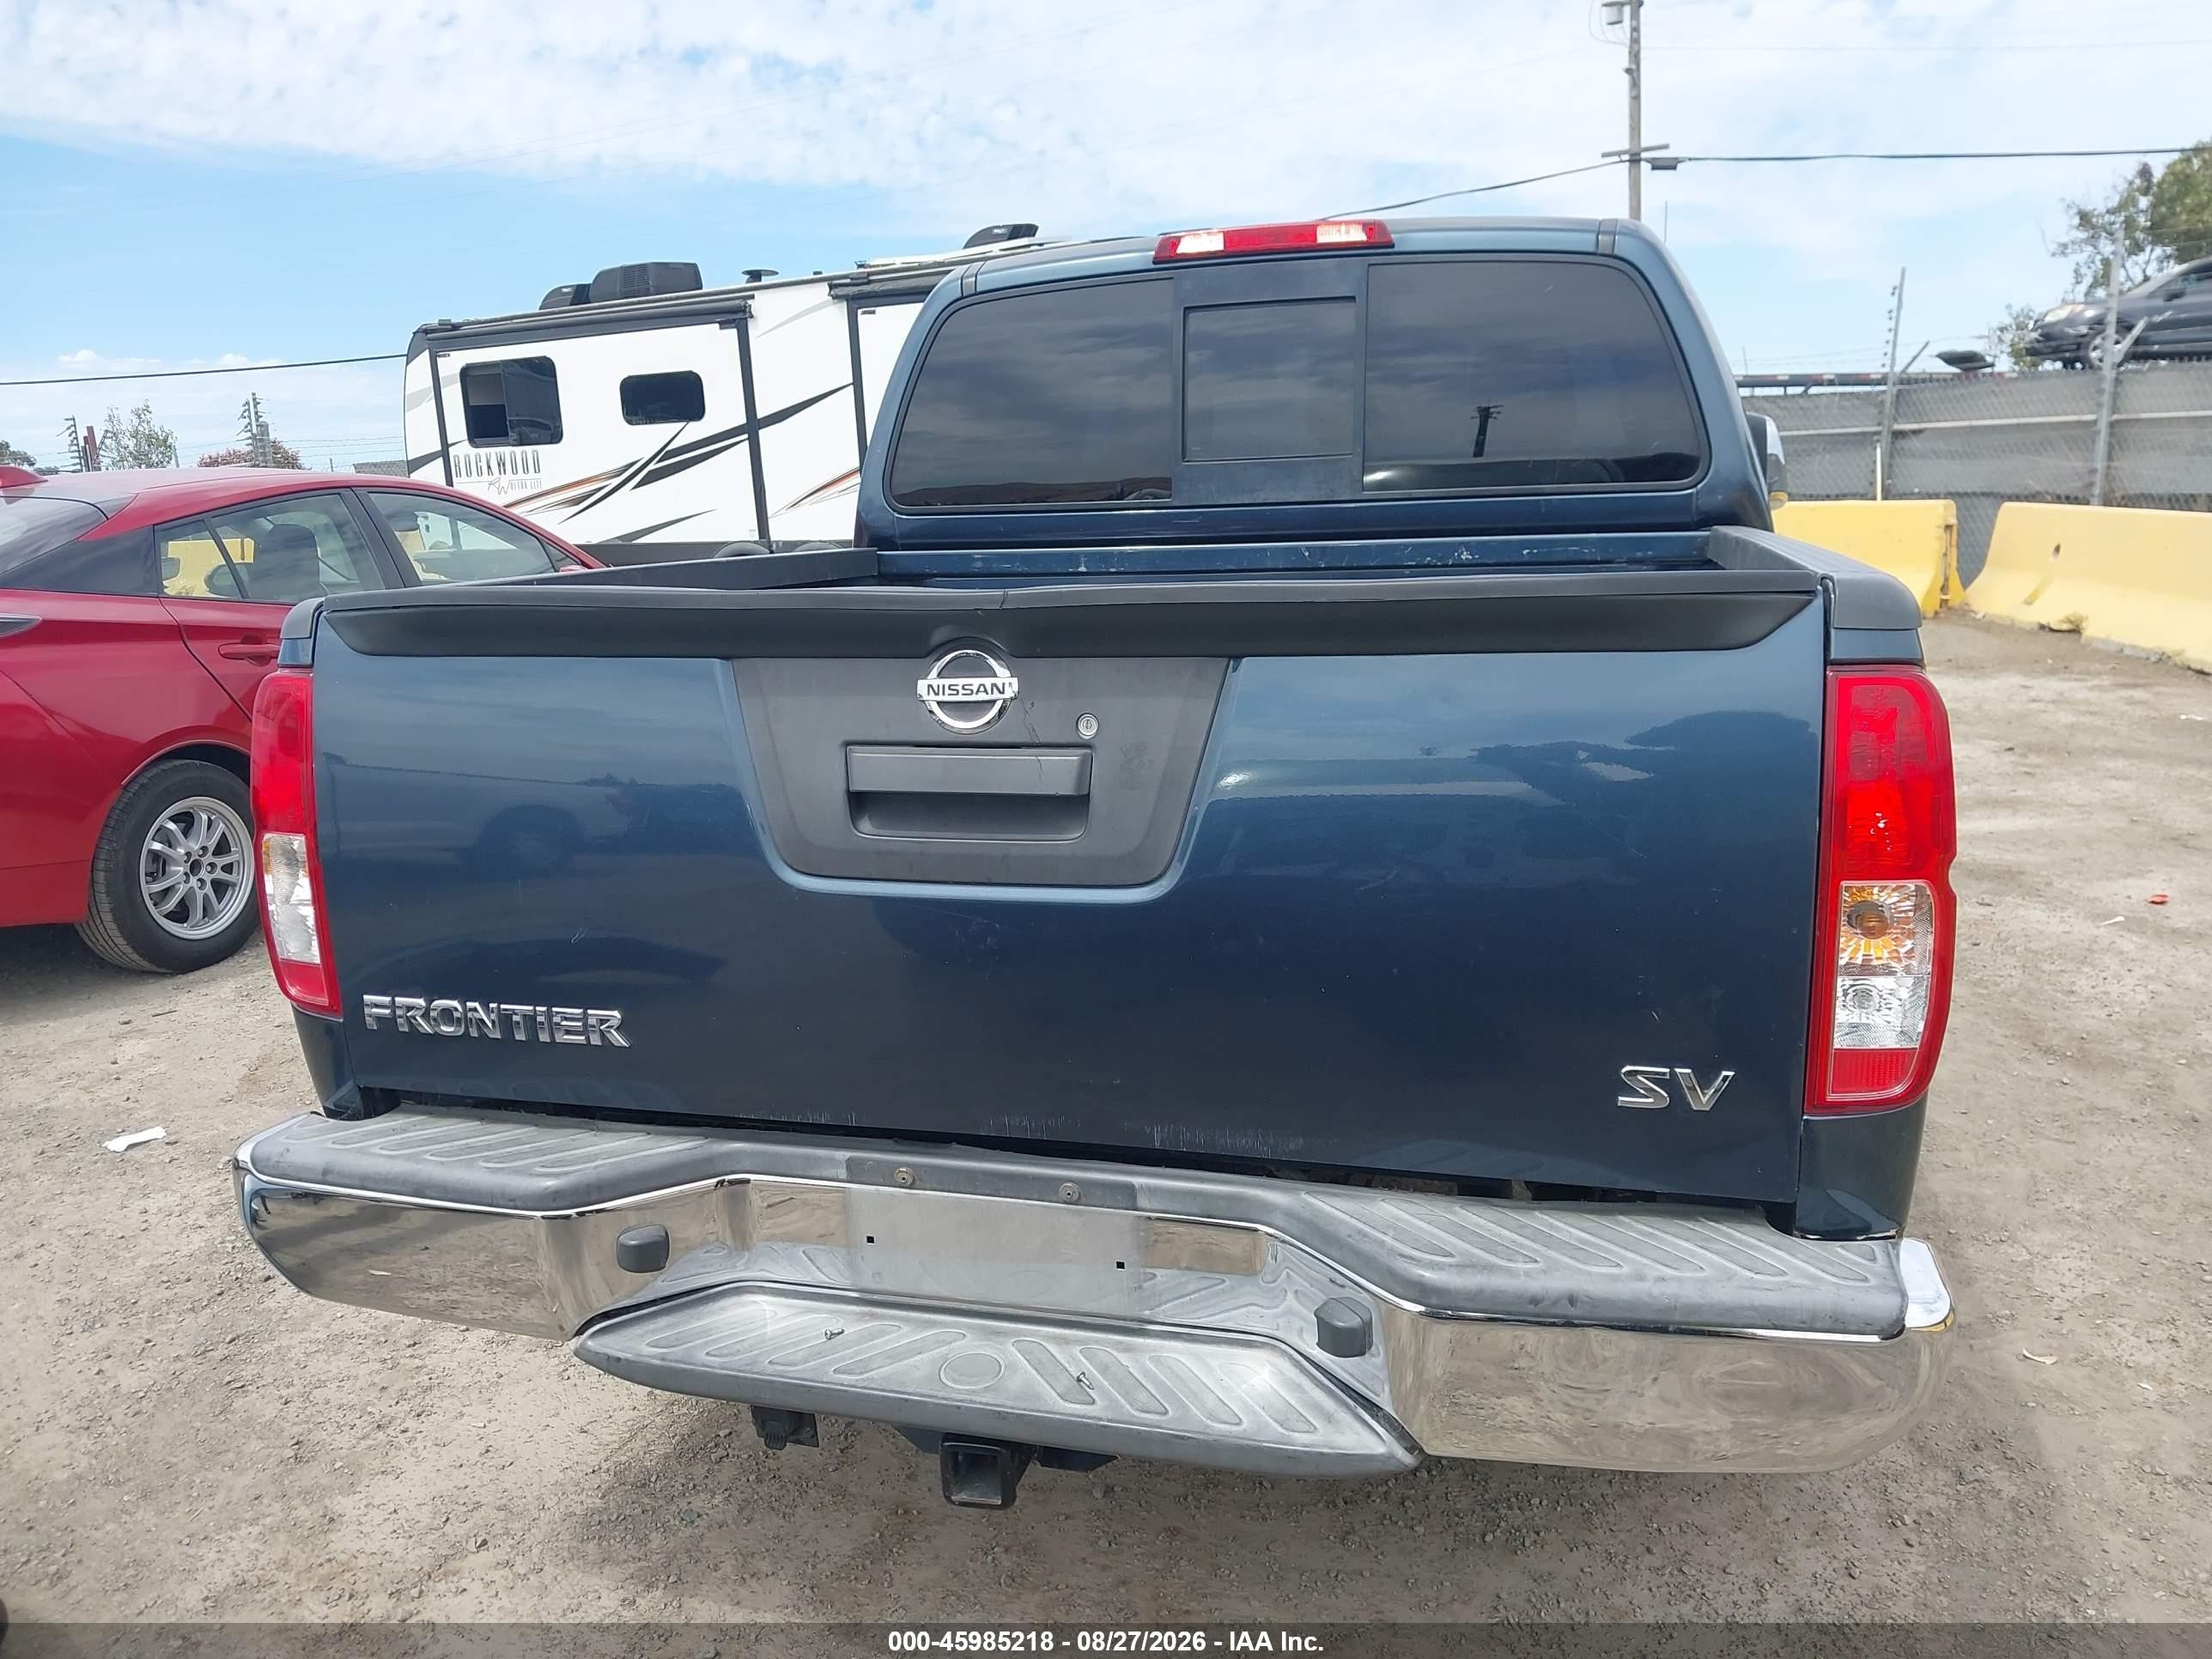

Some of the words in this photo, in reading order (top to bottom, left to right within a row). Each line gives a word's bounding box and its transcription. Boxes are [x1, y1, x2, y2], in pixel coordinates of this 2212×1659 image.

[453, 449, 541, 478] ROCKWOOD
[927, 682, 1006, 697] NISSAN
[362, 994, 633, 1048] FRONTIER
[1617, 1065, 1736, 1112] SV
